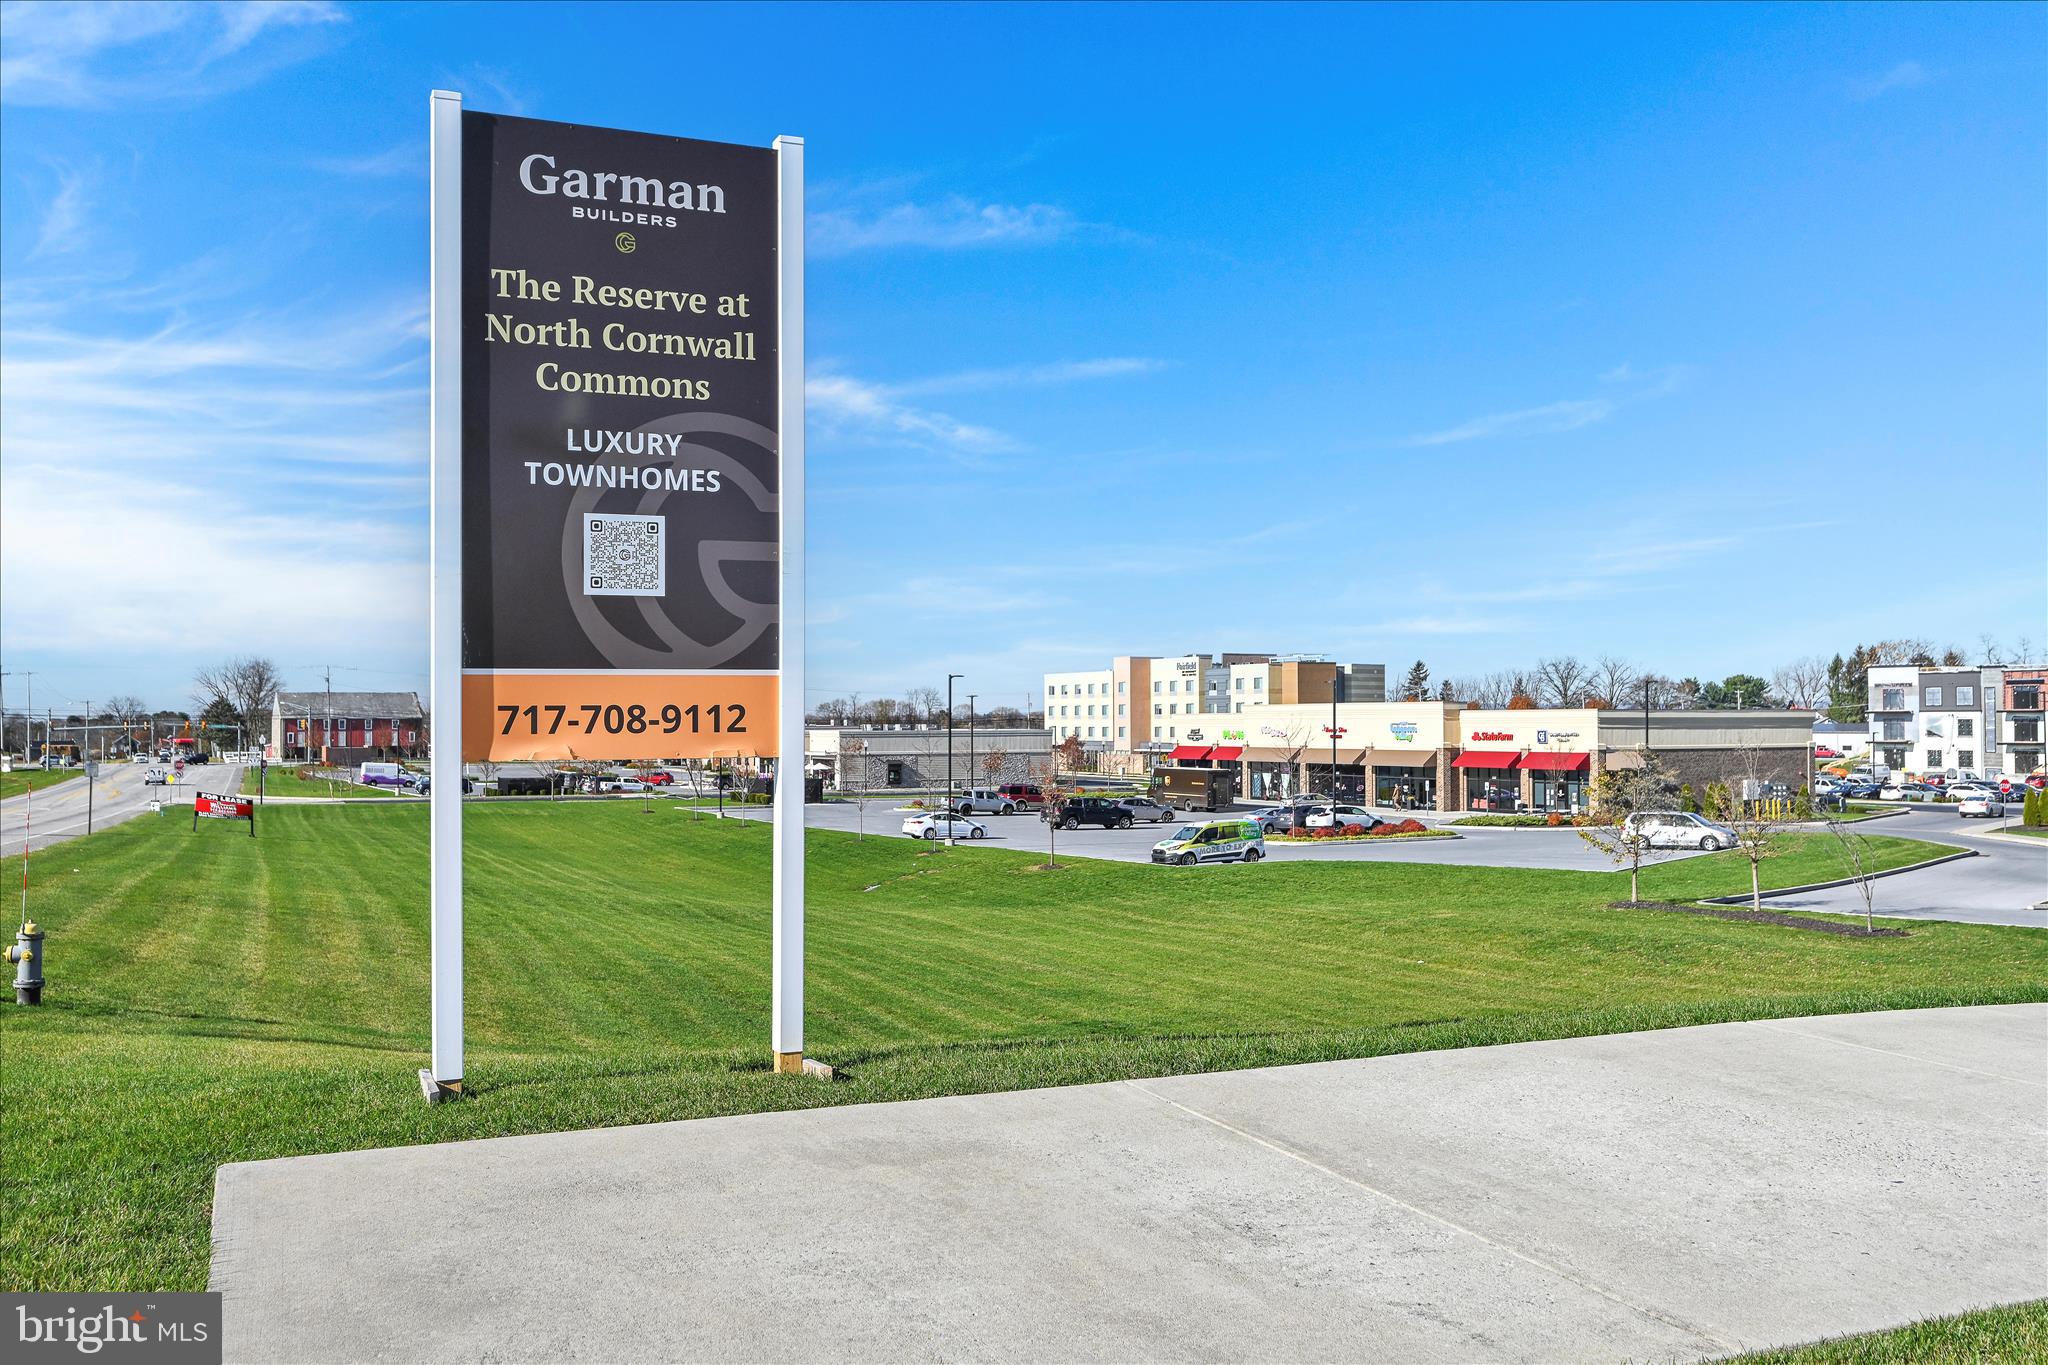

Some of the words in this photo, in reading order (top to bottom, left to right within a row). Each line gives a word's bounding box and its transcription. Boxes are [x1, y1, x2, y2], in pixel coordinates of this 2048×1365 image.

[519, 153, 727, 214] Garman
[572, 206, 678, 229] BUILDERS
[490, 267, 561, 303] The
[571, 275, 708, 315] Reserve
[716, 290, 750, 319] at
[484, 312, 593, 350] North
[602, 323, 757, 362] Cornwall
[535, 362, 712, 401] Commons
[566, 428, 683, 458] LUXURY
[523, 461, 721, 493] TOWNHOMES
[496, 704, 748, 736] 717-708-9112
[220, 796, 247, 804] LEASE
[1200, 845, 1221, 855] MORE
[1222, 844, 1232, 853] TO
